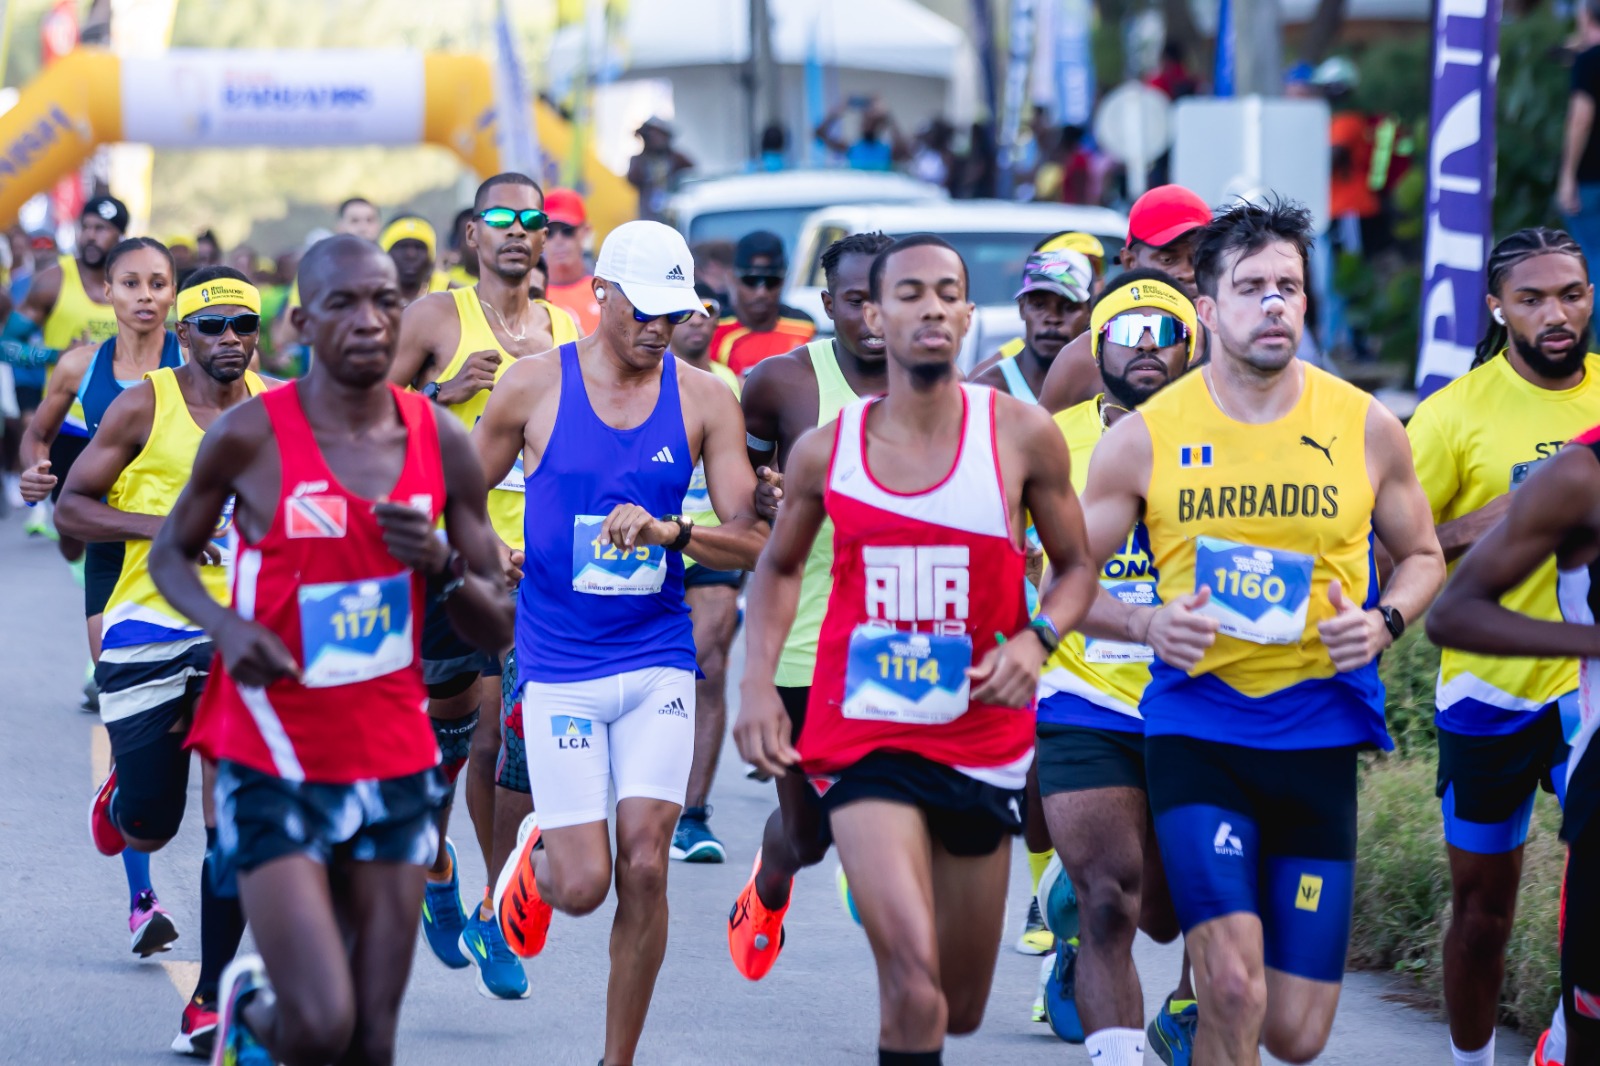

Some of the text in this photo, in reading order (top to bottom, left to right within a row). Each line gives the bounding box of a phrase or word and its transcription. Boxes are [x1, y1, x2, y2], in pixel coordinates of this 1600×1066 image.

[1179, 483, 1339, 523] BARBADOS
[1214, 568, 1287, 605] 1160
[331, 604, 392, 641] 1171
[876, 653, 941, 685] 1114
[658, 705, 689, 719] adidas
[558, 737, 591, 749] LCA
